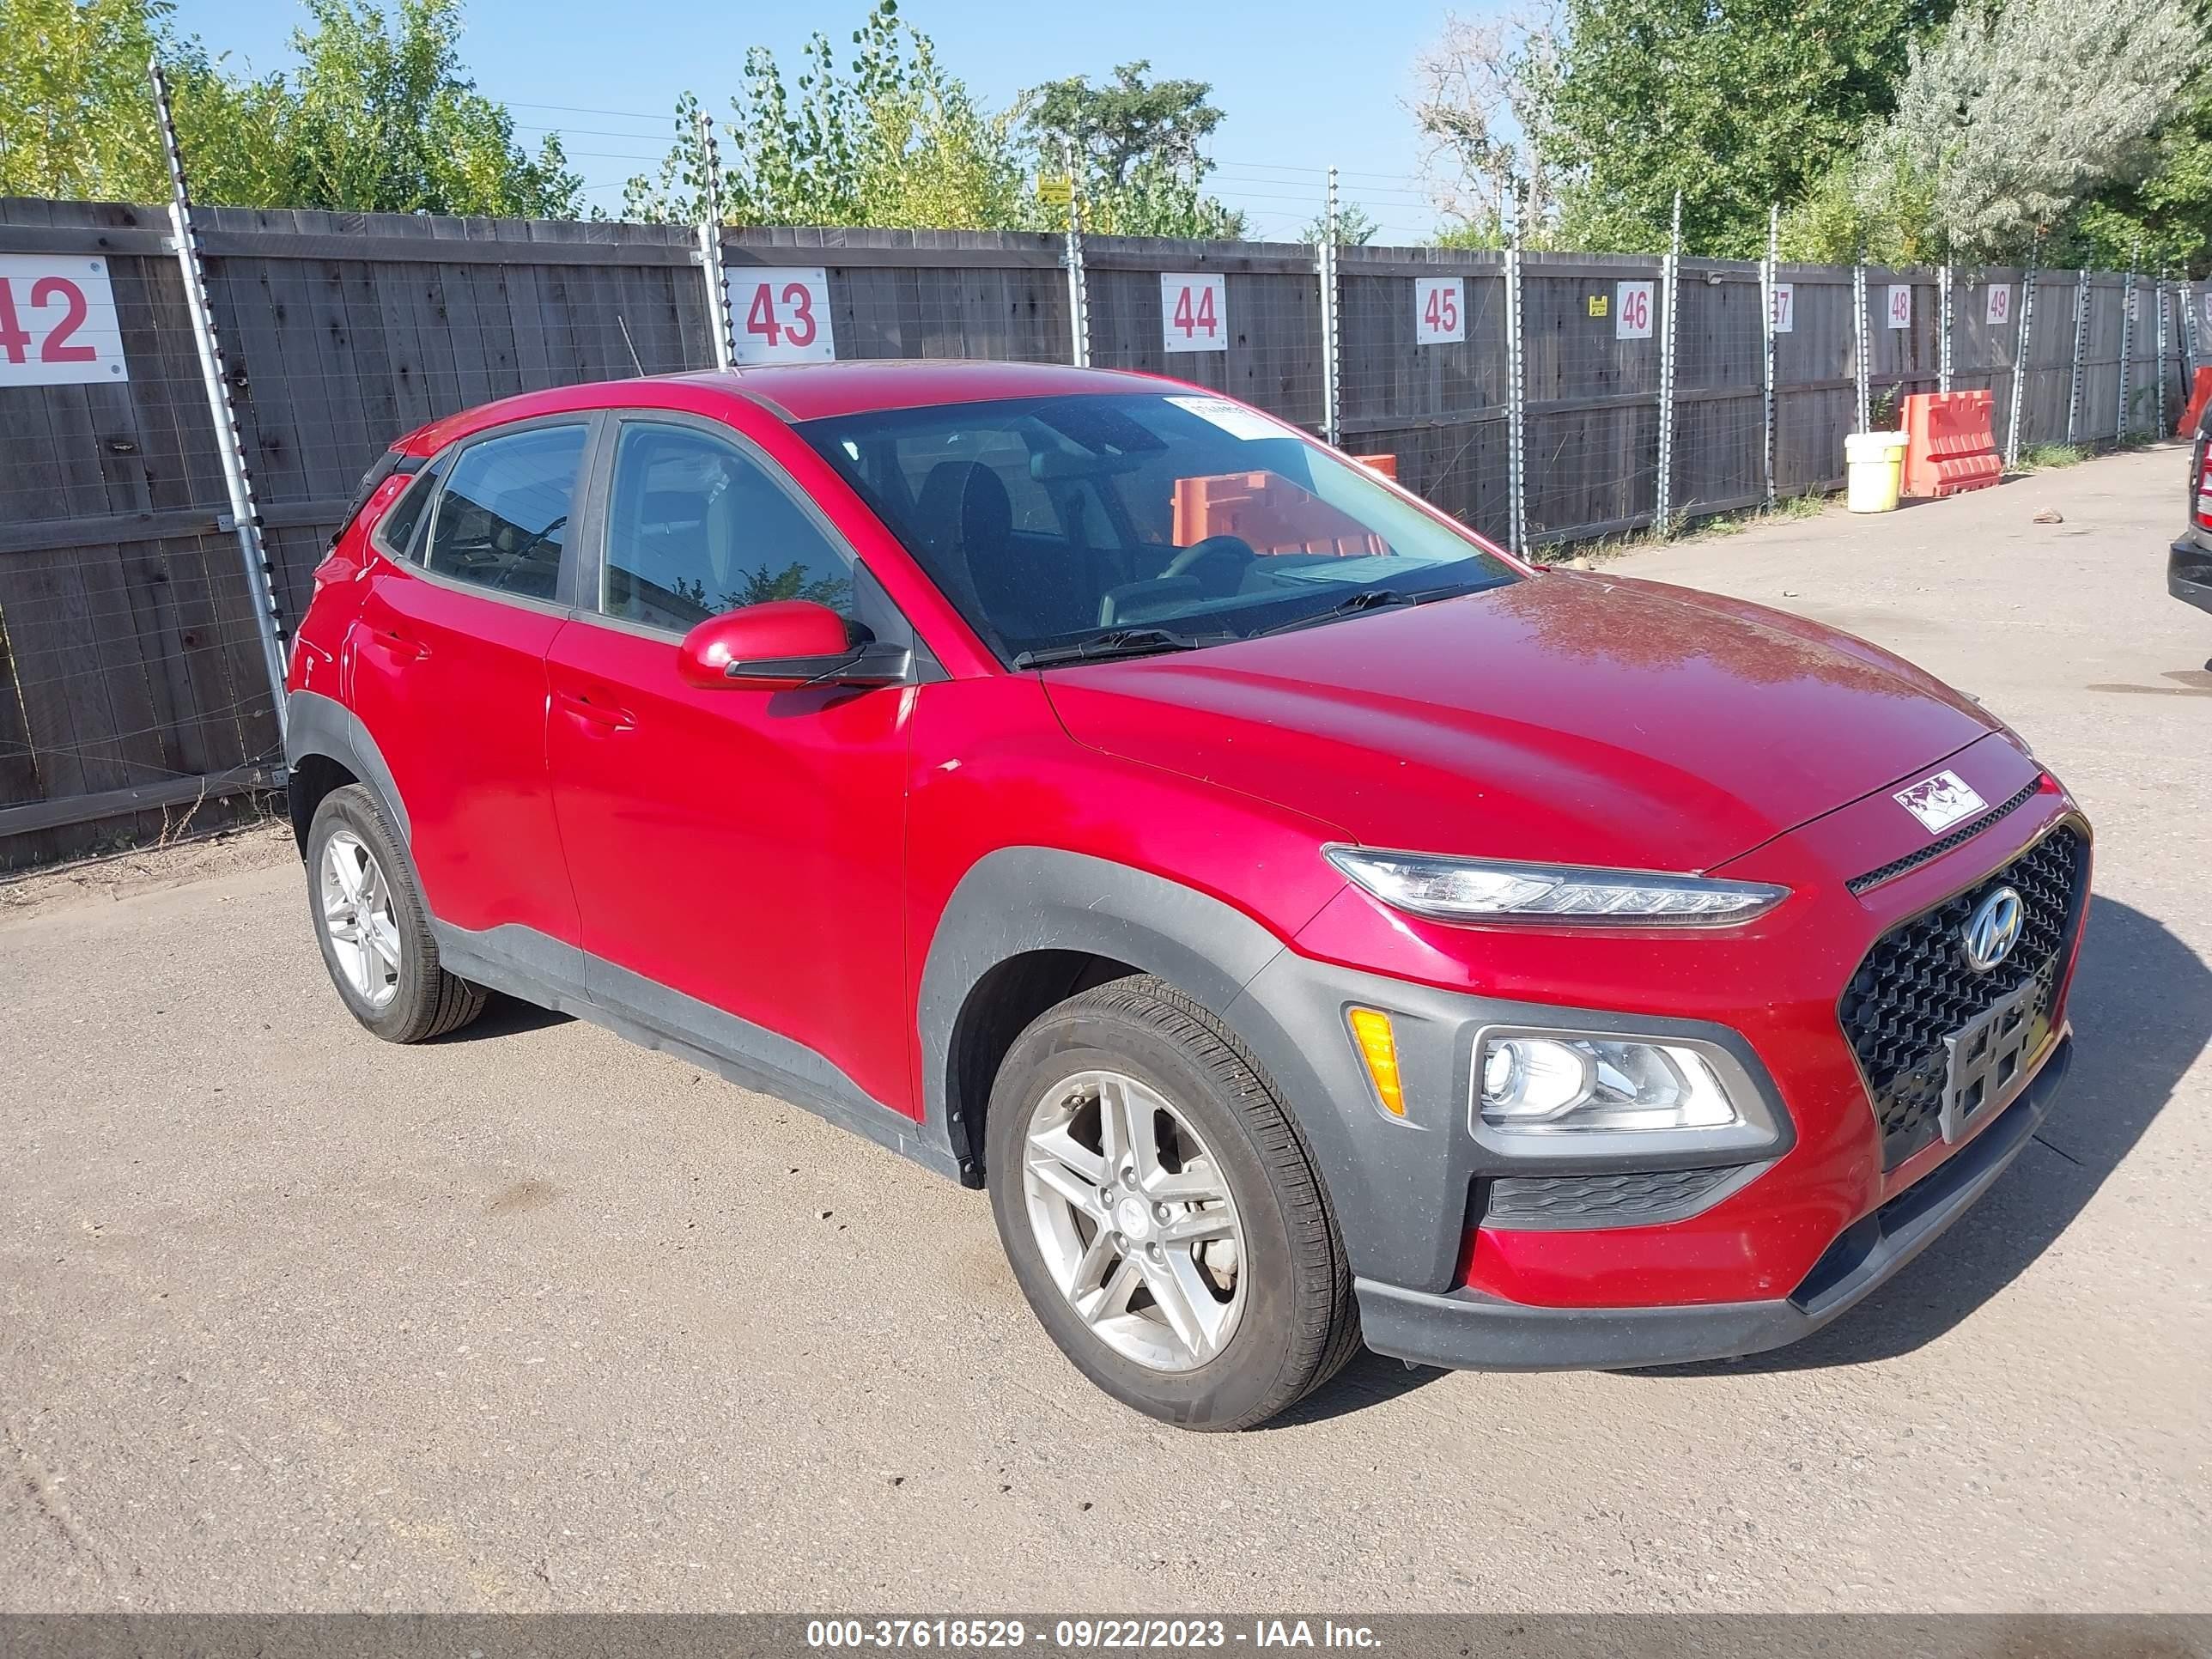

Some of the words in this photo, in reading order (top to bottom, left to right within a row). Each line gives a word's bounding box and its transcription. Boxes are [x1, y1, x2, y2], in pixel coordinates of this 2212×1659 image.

[746, 283, 817, 348] 43
[1174, 286, 1218, 338] 44
[1425, 288, 1457, 333] 45
[1623, 290, 1648, 330] 46
[1892, 291, 1907, 321] 48
[1990, 289, 2006, 318] 49
